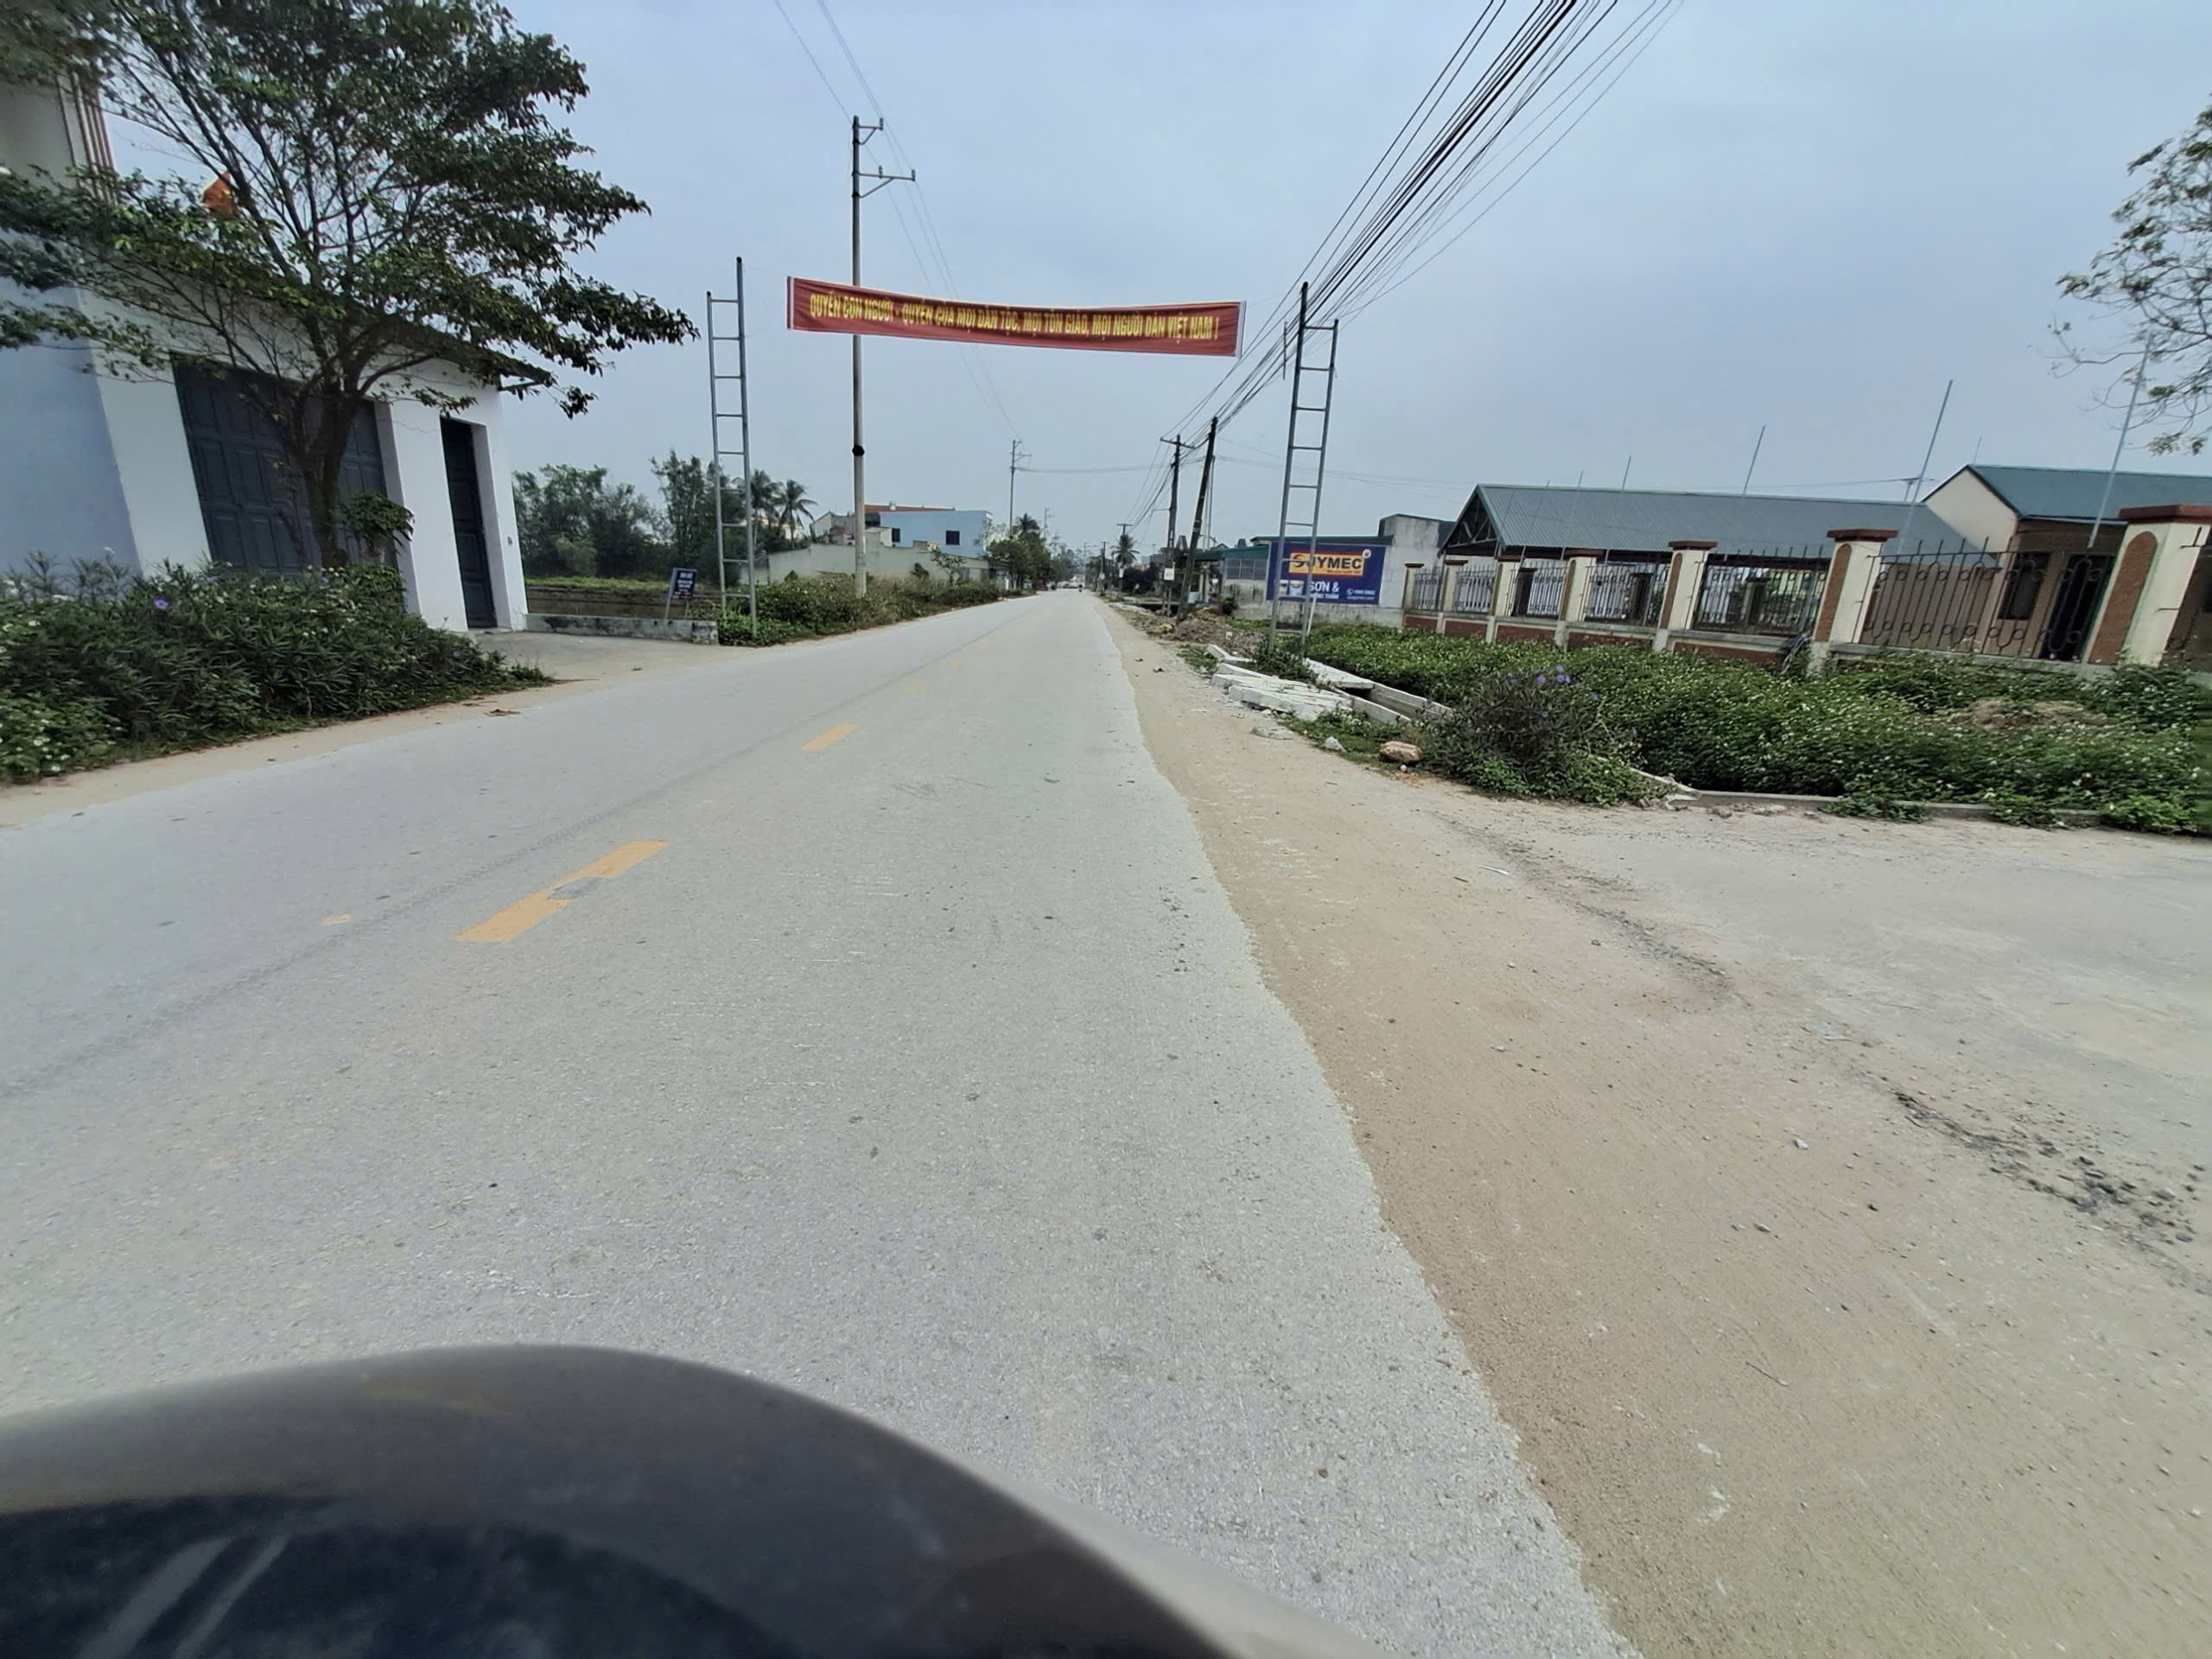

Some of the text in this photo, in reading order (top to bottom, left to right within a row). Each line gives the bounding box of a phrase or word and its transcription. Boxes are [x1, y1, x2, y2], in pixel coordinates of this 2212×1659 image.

[842, 296, 862, 319] CON
[1044, 308, 1064, 334] TÔN
[1091, 314, 1112, 340] MỌI
[1112, 310, 1142, 337] NGƯỜI
[1145, 311, 1166, 338] DÂN
[1167, 311, 1189, 344] VIỆT
[1189, 315, 1213, 340] NAM
[1332, 582, 1340, 593] &
